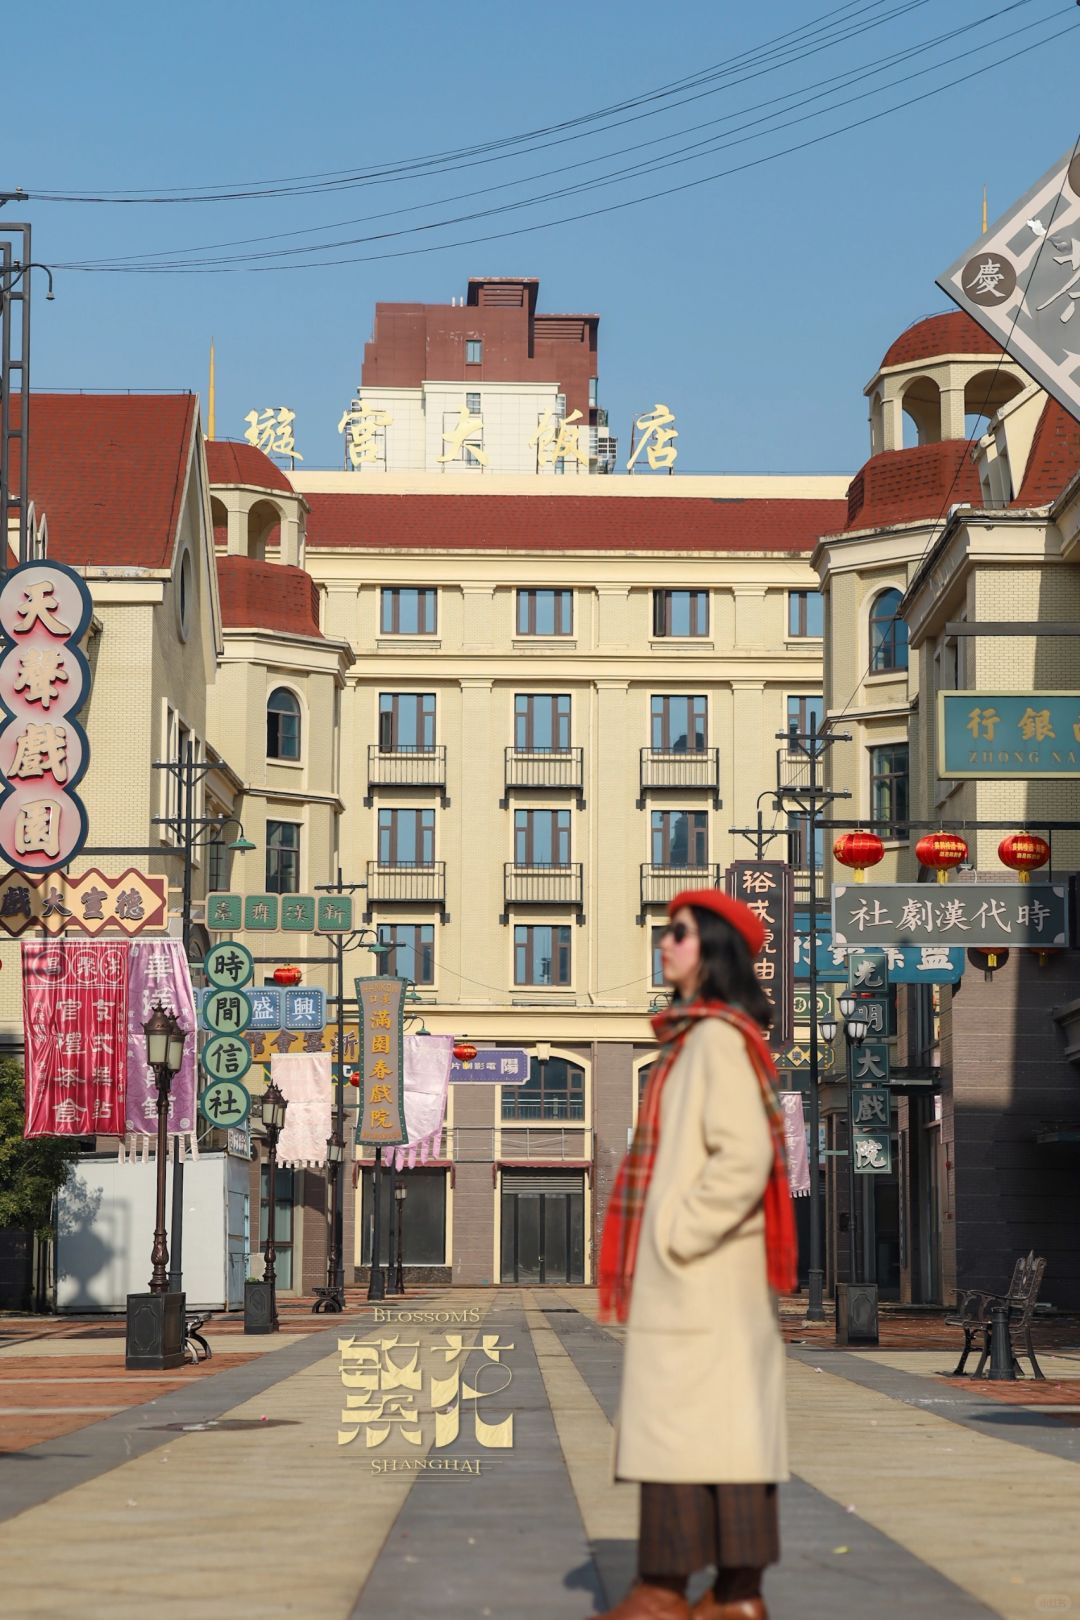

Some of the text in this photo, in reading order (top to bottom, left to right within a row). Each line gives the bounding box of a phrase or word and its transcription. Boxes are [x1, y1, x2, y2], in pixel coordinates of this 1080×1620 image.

[966, 258, 1006, 297] 慶
[208, 950, 245, 1118] 時間信社
